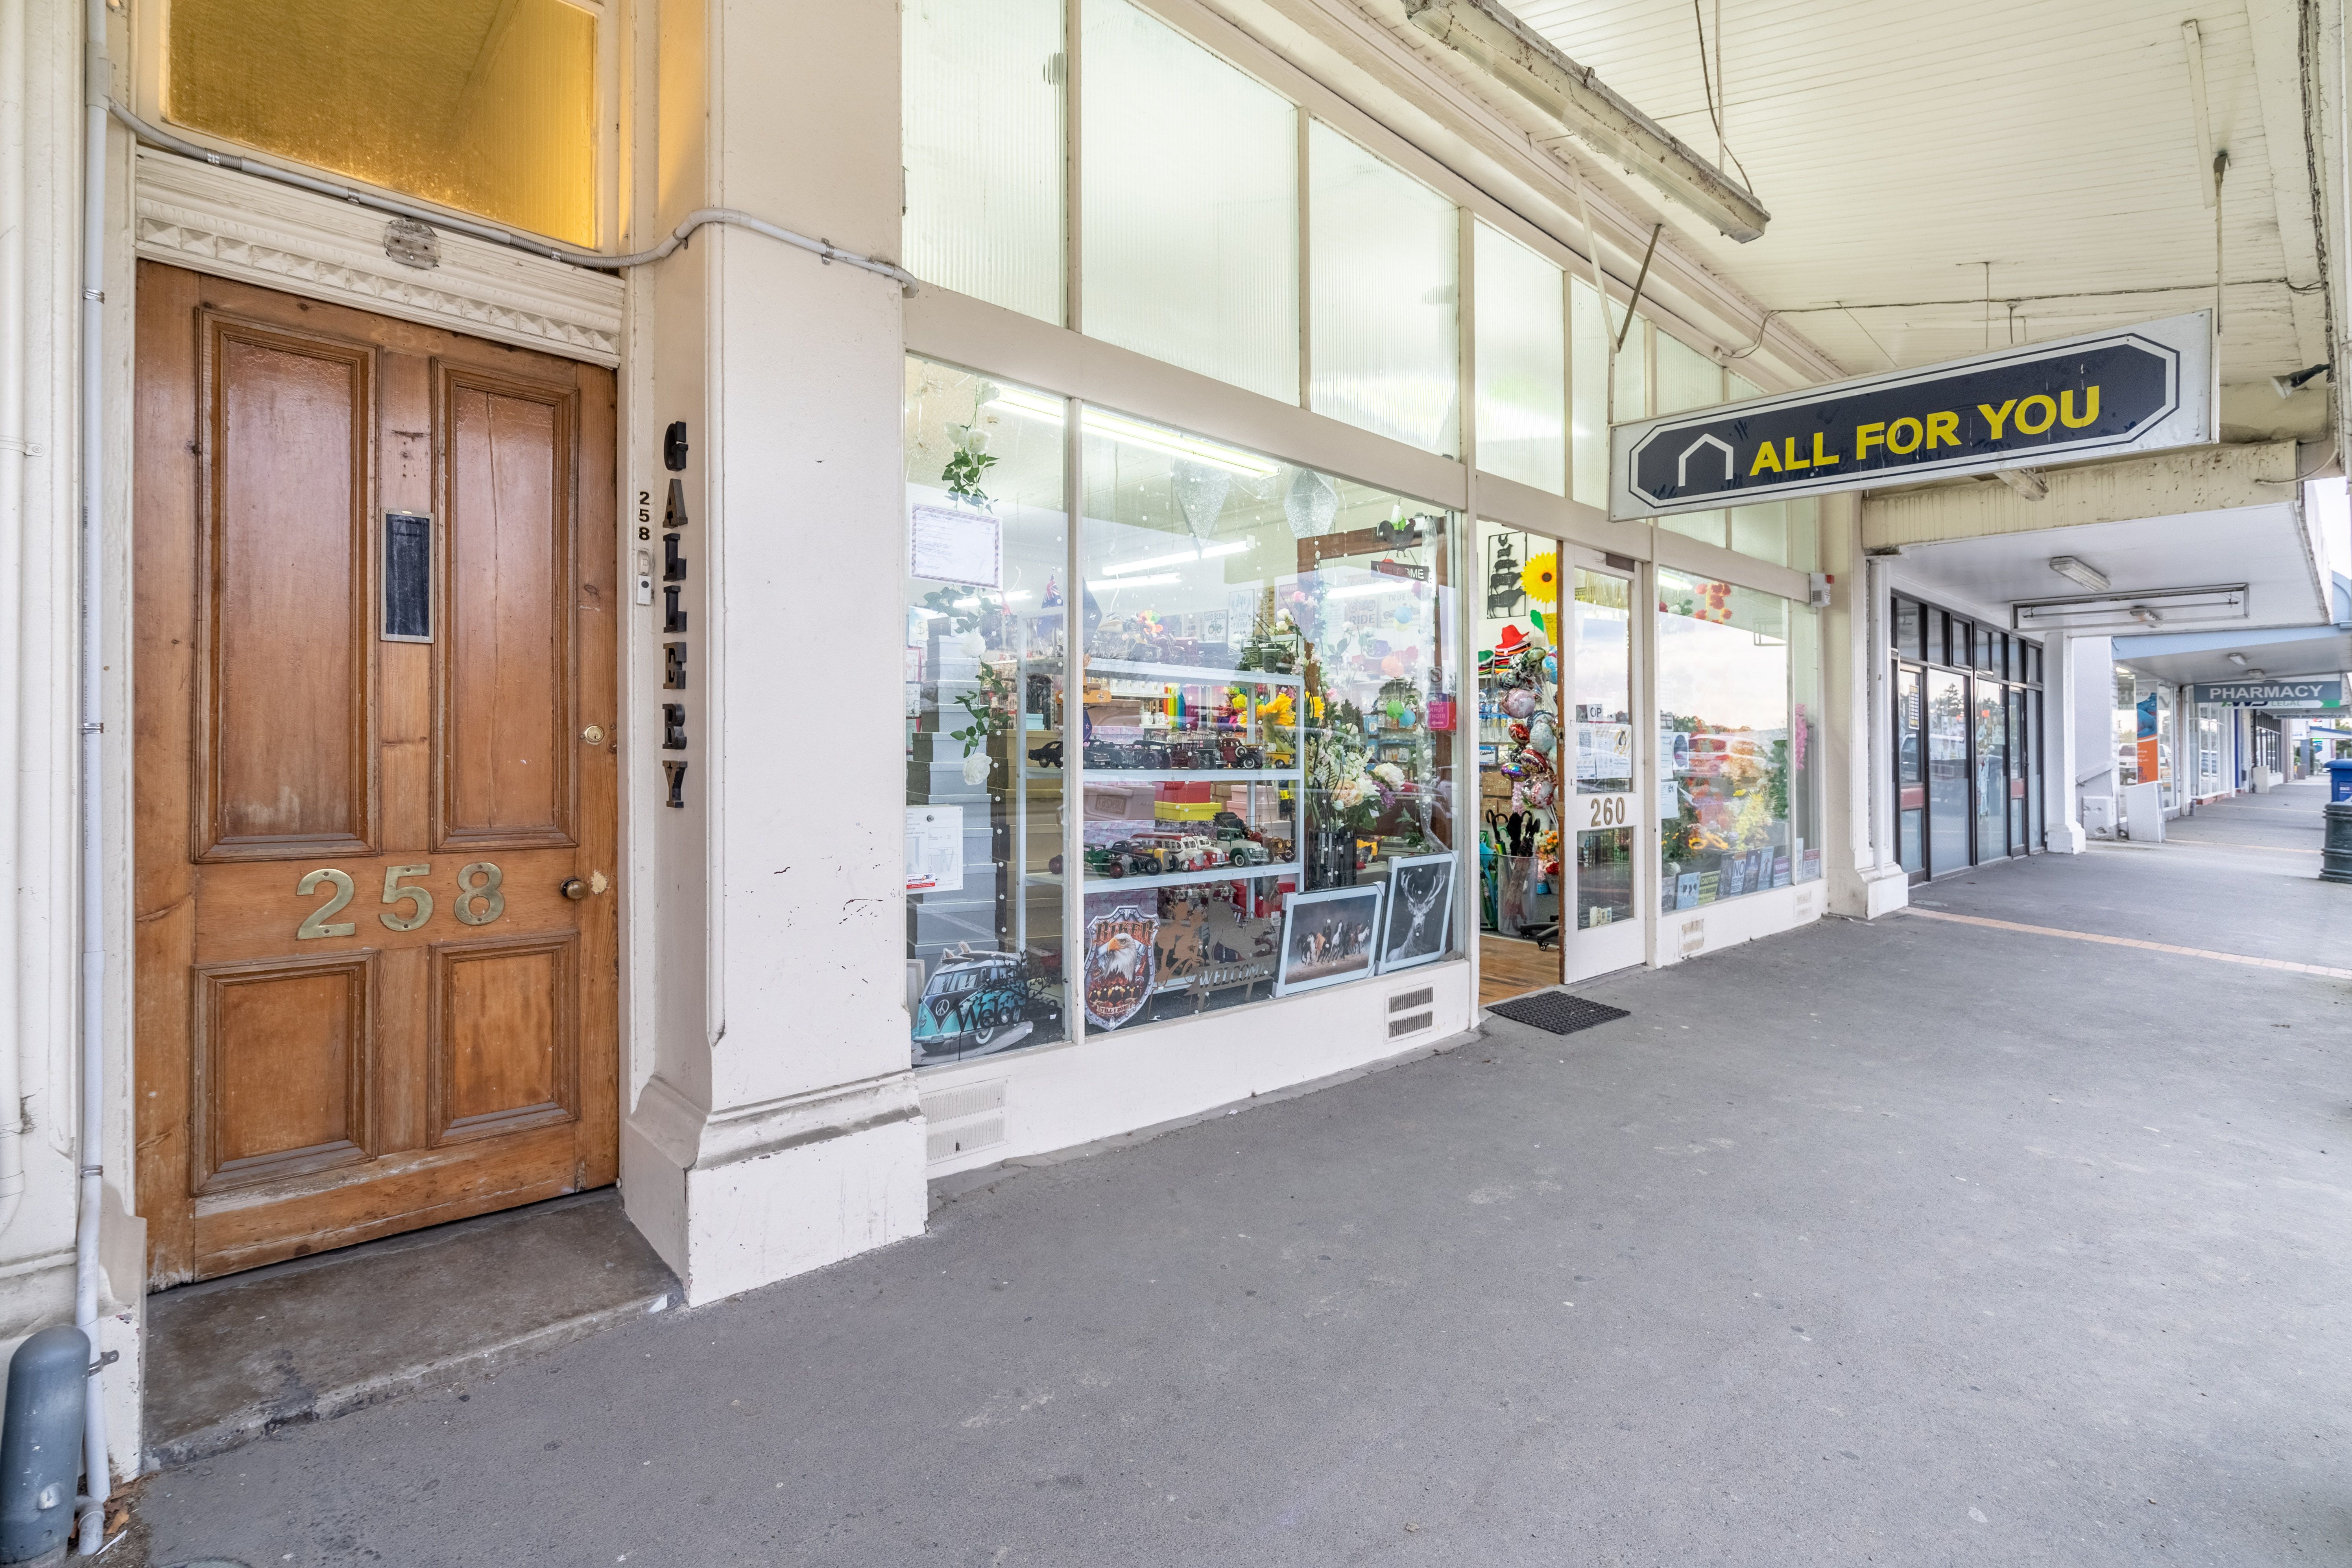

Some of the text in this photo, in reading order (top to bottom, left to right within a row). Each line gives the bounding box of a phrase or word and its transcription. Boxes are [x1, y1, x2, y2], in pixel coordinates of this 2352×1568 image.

[1749, 384, 2100, 476] ALL FOR YOU
[638, 491, 650, 541] 258
[1388, 593, 1406, 602] TRUE
[662, 421, 689, 808] GALLERY
[1350, 614, 1375, 626] RIDE
[2210, 685, 2323, 699] PHARMACY
[1591, 797, 1625, 827] 260
[1733, 861, 1745, 877] NO
[296, 862, 505, 940] 258
[1093, 920, 1155, 946] BIKER
[1199, 962, 1268, 988] WELCOME
